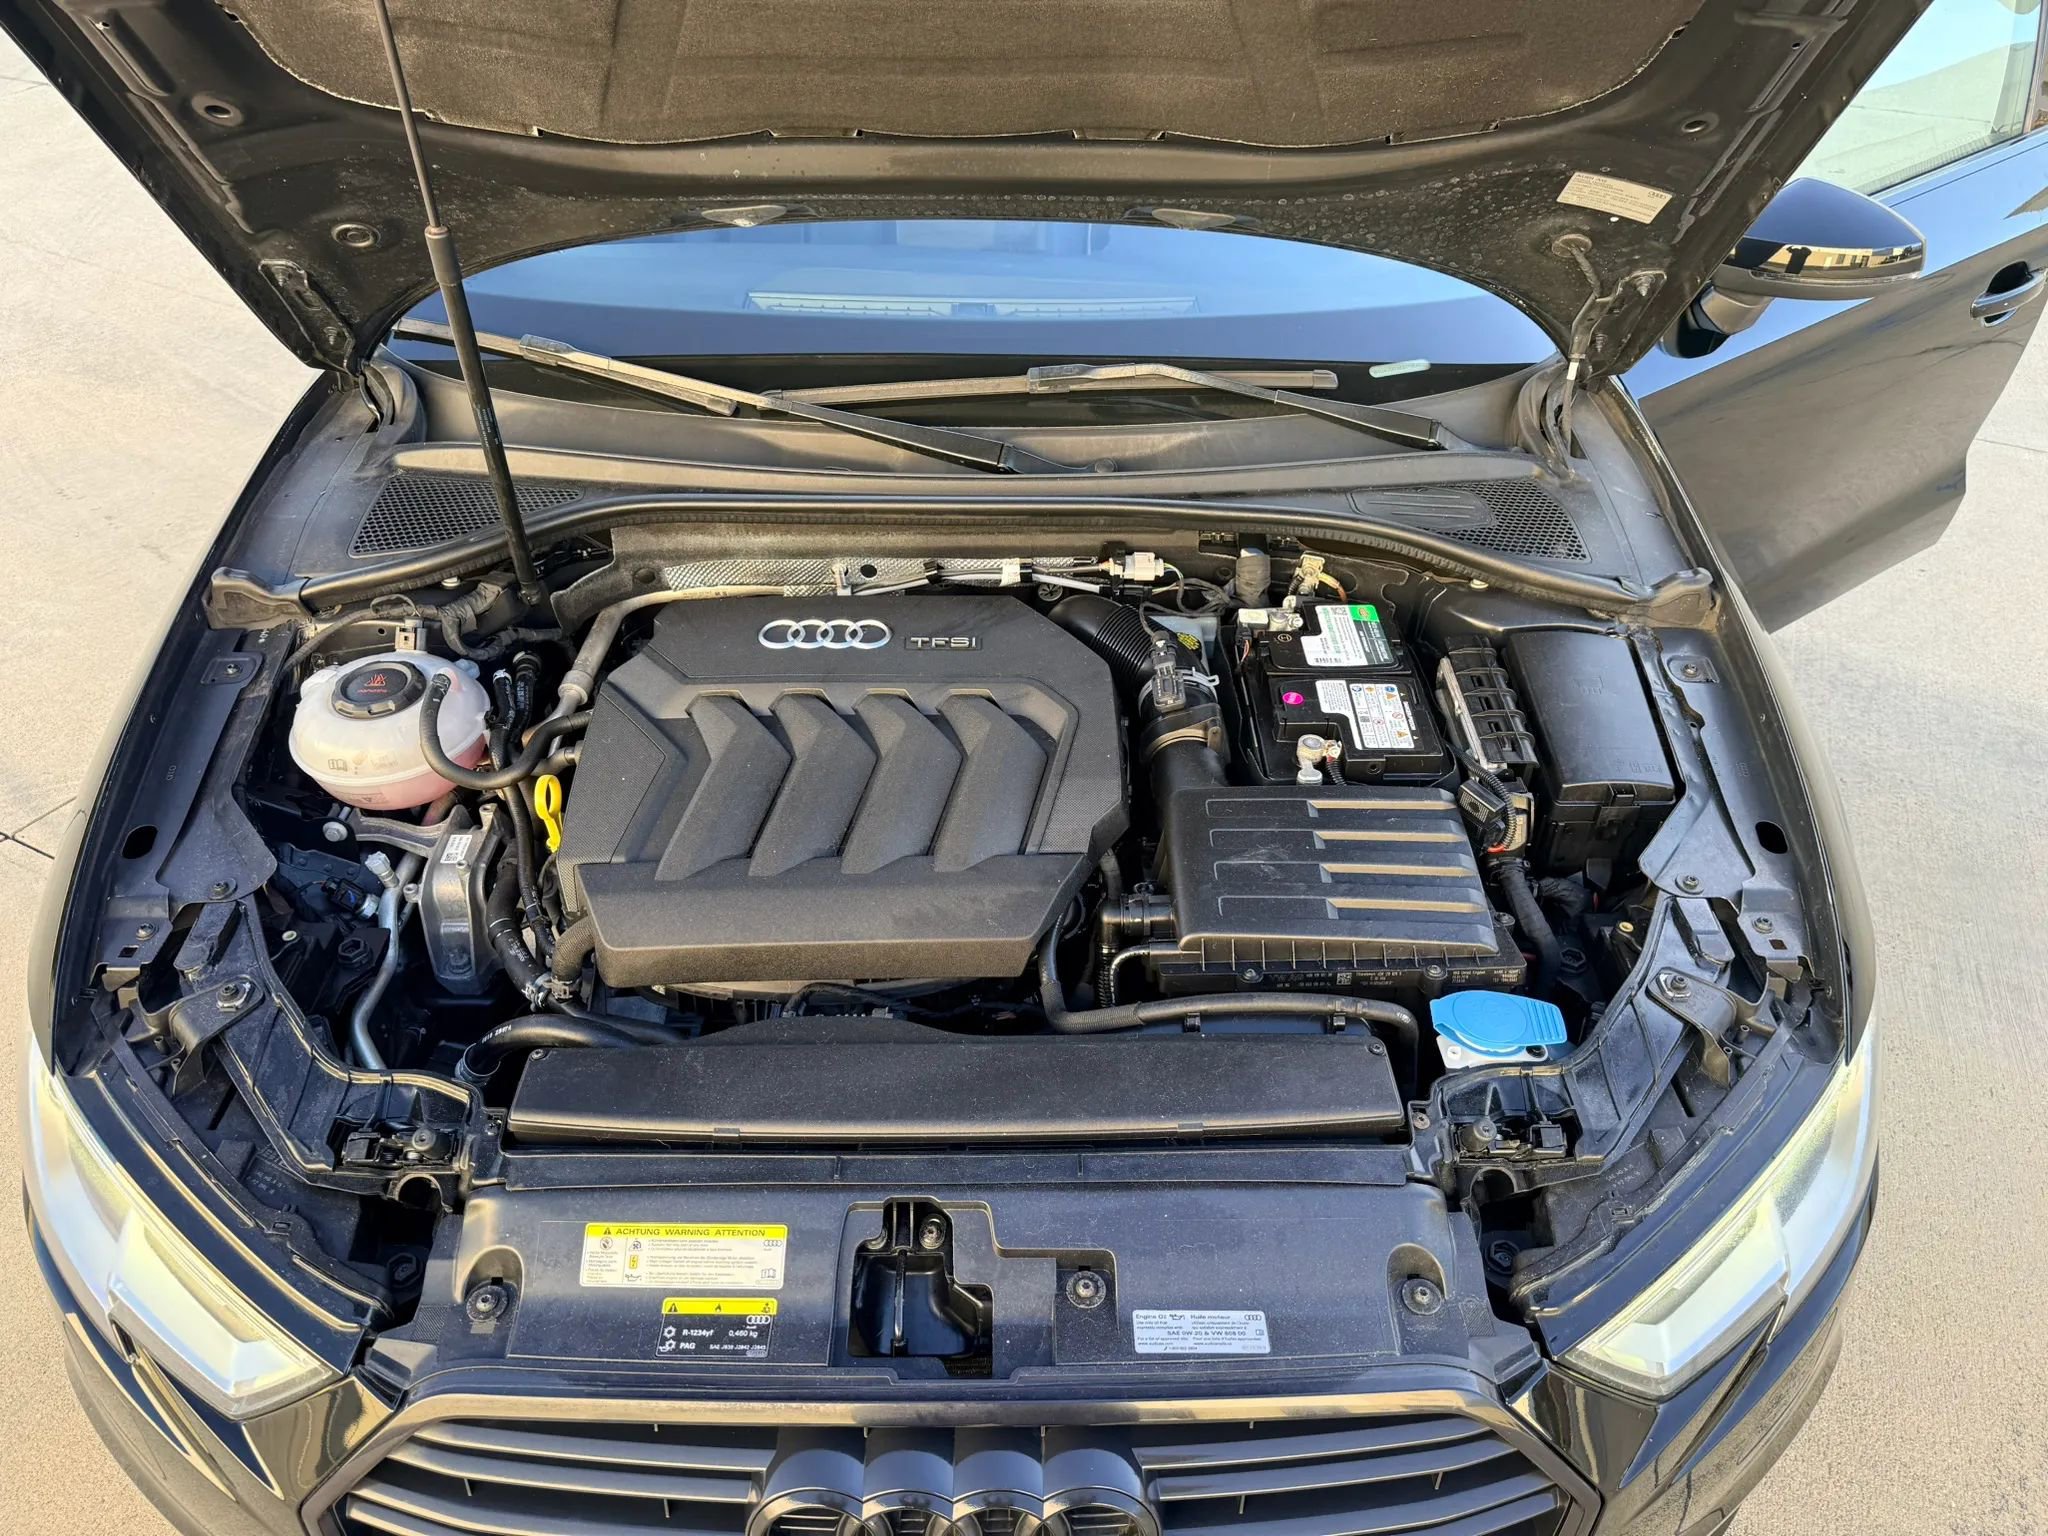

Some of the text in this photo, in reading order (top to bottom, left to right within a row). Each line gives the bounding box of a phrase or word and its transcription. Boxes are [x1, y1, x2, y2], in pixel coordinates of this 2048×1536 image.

[910, 637, 977, 648] TFSI
[682, 1329, 714, 1337] R-1234yf
[749, 1330, 758, 1338] kg
